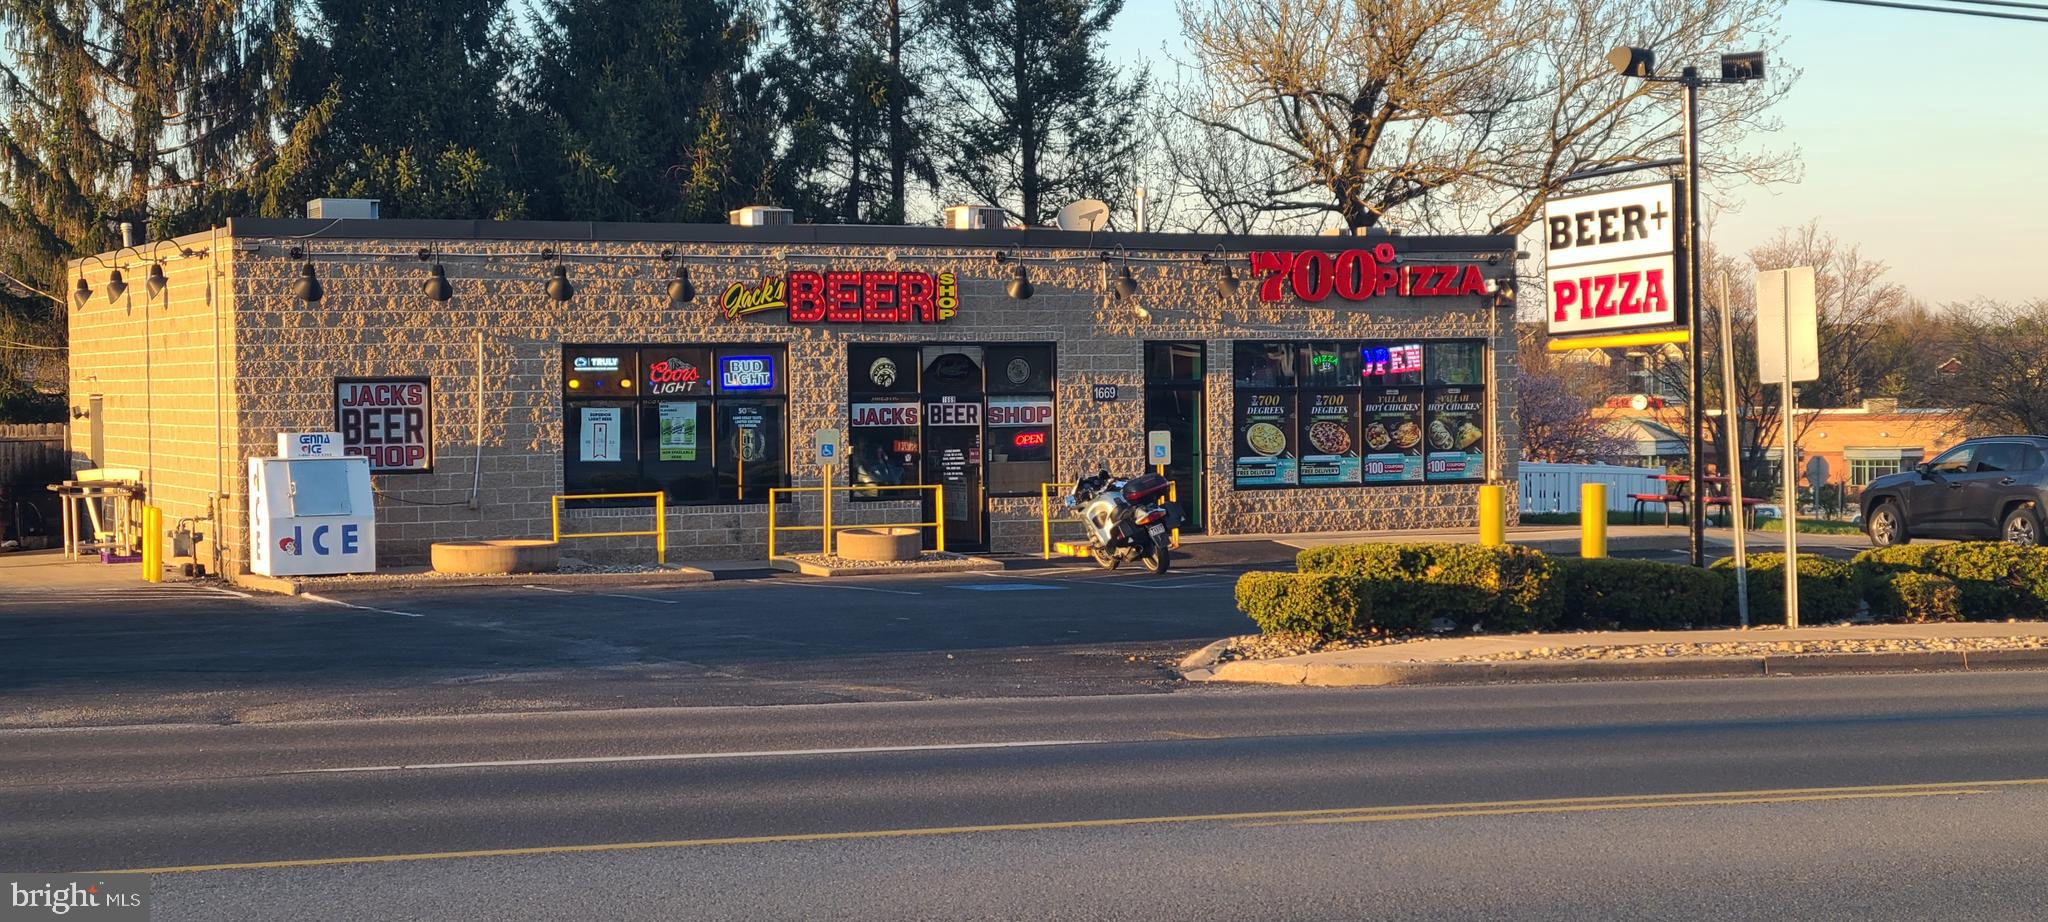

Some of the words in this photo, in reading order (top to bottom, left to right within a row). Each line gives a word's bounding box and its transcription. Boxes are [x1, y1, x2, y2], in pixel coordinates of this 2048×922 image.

[1376, 263, 1488, 296] PIZZA
[721, 276, 787, 318] Jack's
[788, 271, 935, 323] BEER
[937, 271, 958, 321] SHOP
[1553, 268, 1669, 322] PIZZA
[591, 357, 619, 366] TRULY
[730, 359, 764, 373] BUD
[649, 361, 700, 382] Coors
[724, 372, 770, 387] LIGHT
[653, 381, 697, 395] LIGHT
[1094, 386, 1116, 400] 1669
[342, 384, 423, 407] JACKS
[1258, 394, 1281, 406] 700
[1322, 394, 1345, 406] 700
[1247, 406, 1285, 415] DEGREES
[1311, 406, 1348, 415] DEGREES
[1365, 402, 1385, 412] HOT
[1384, 402, 1421, 412] CHICKEN
[1428, 402, 1447, 411] HOT
[1446, 402, 1483, 411] CHICKEN
[853, 407, 918, 426] JACKS
[930, 403, 979, 425] BEER
[989, 406, 1052, 425] SHOP
[342, 407, 424, 446] BEER
[300, 435, 330, 444] GENNA
[1015, 433, 1044, 446] OPEN
[308, 444, 322, 454] ICE
[1365, 462, 1384, 474] $100
[1427, 460, 1446, 472] $100
[294, 524, 358, 556] ICE
